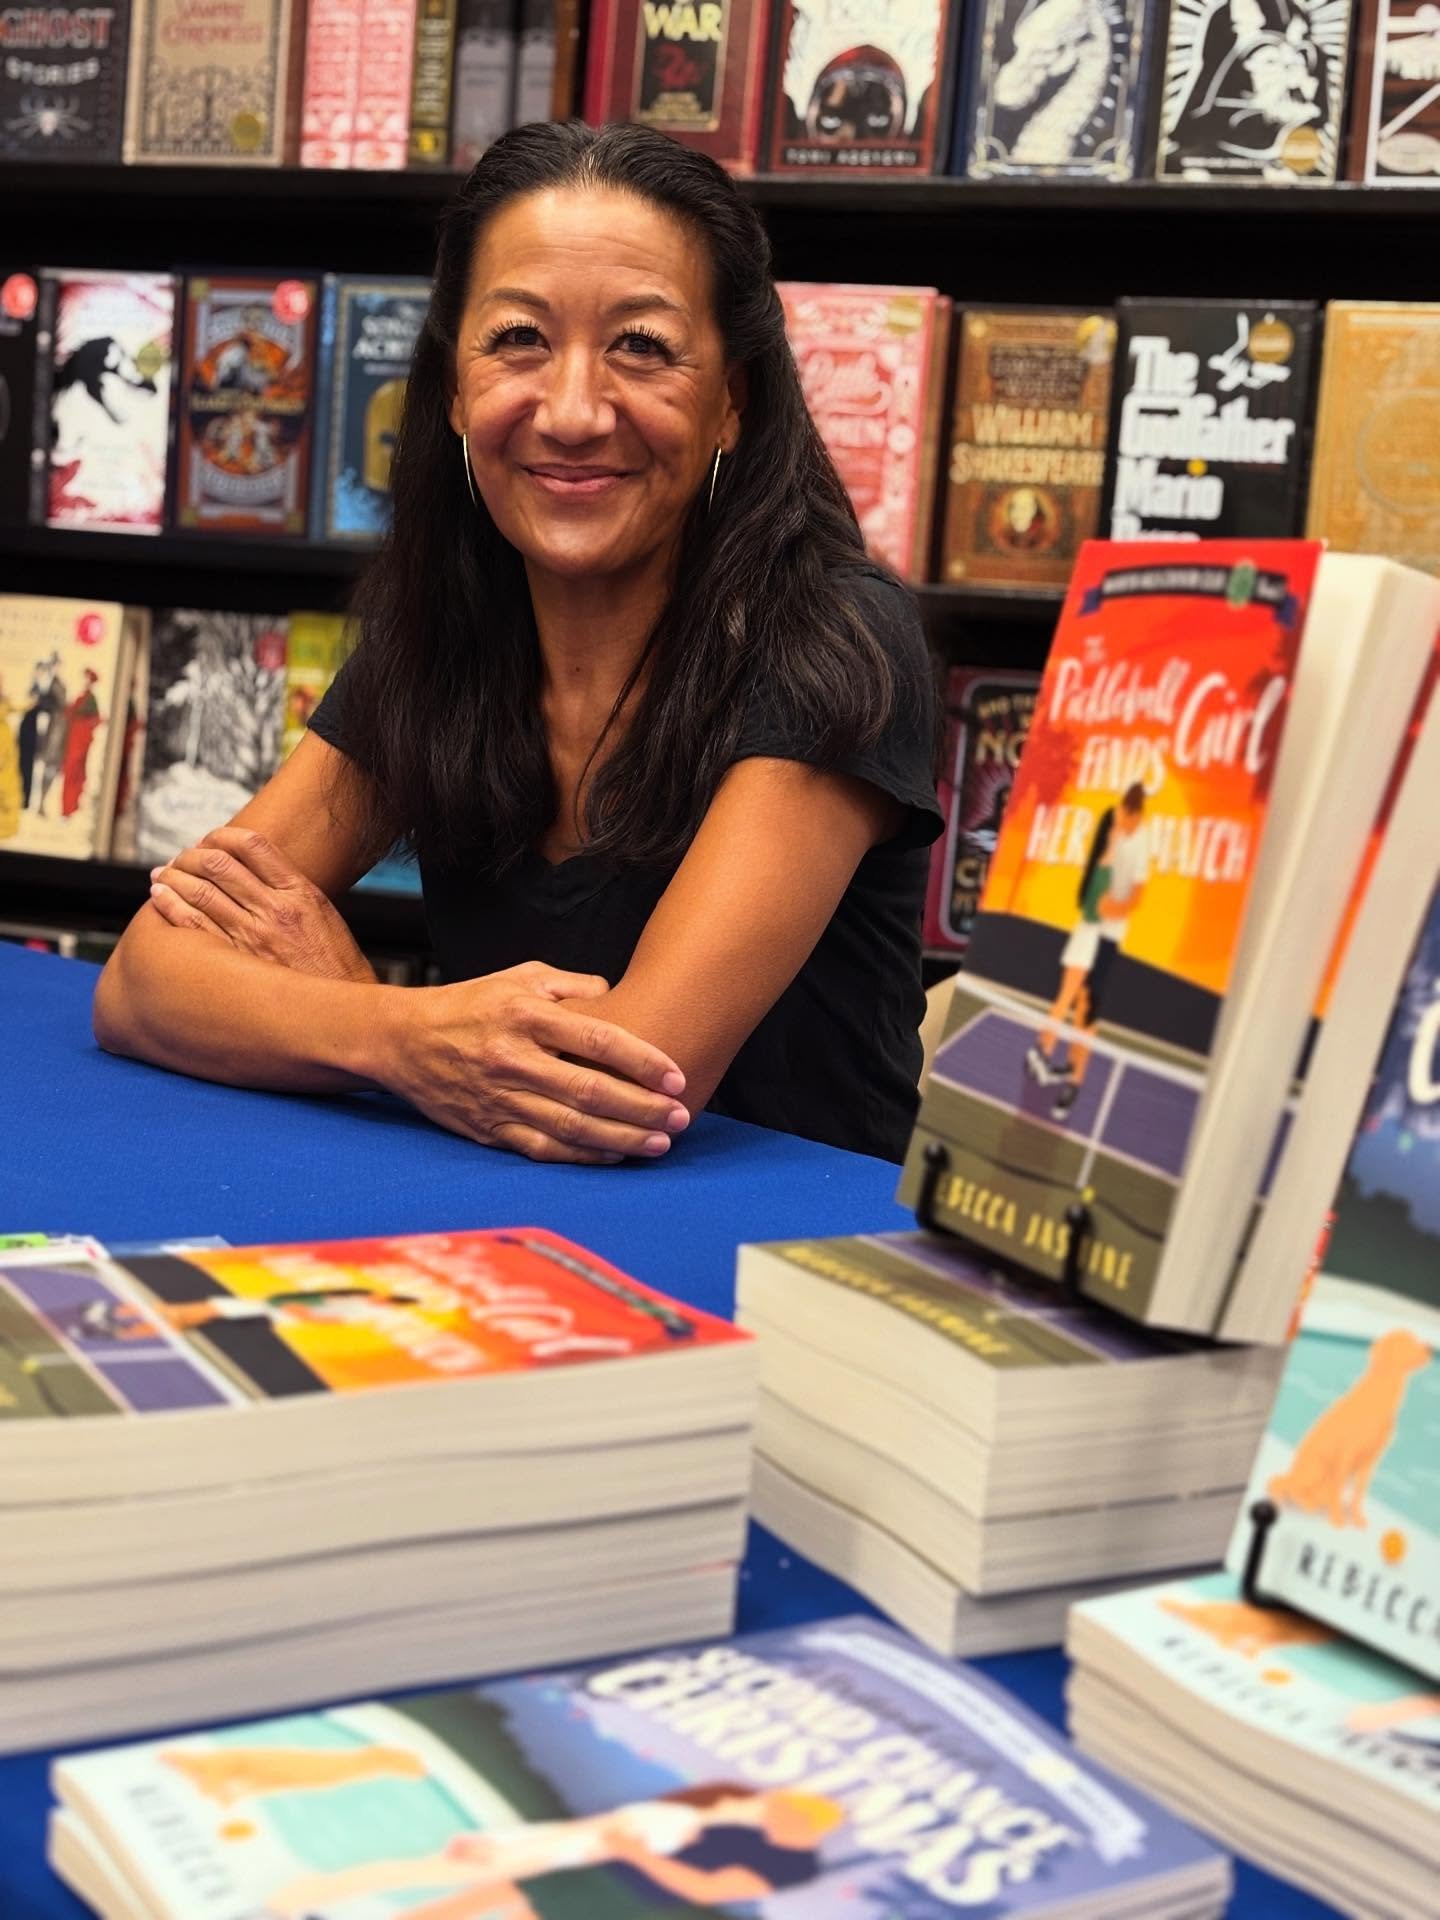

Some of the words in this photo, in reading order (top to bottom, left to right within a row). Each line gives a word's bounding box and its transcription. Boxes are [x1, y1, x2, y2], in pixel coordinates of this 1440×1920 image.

[0, 8, 115, 48] GHOST
[642, 2, 722, 41] WAR
[5, 56, 99, 87] STORIES
[1129, 336, 1200, 396] The
[971, 403, 1095, 446] WILLIAM
[1119, 393, 1295, 464] Godfather
[1113, 455, 1225, 520] Mario
[1048, 657, 1192, 725] Pickleball
[1172, 671, 1287, 774] Girl
[1076, 734, 1170, 796] FINDS
[1026, 803, 1093, 865] HER
[1148, 813, 1251, 882] MATCH
[942, 1175, 1017, 1237] BECCA
[1023, 1212, 1133, 1291] JASINE
[1299, 1540, 1440, 1640] REBECC
